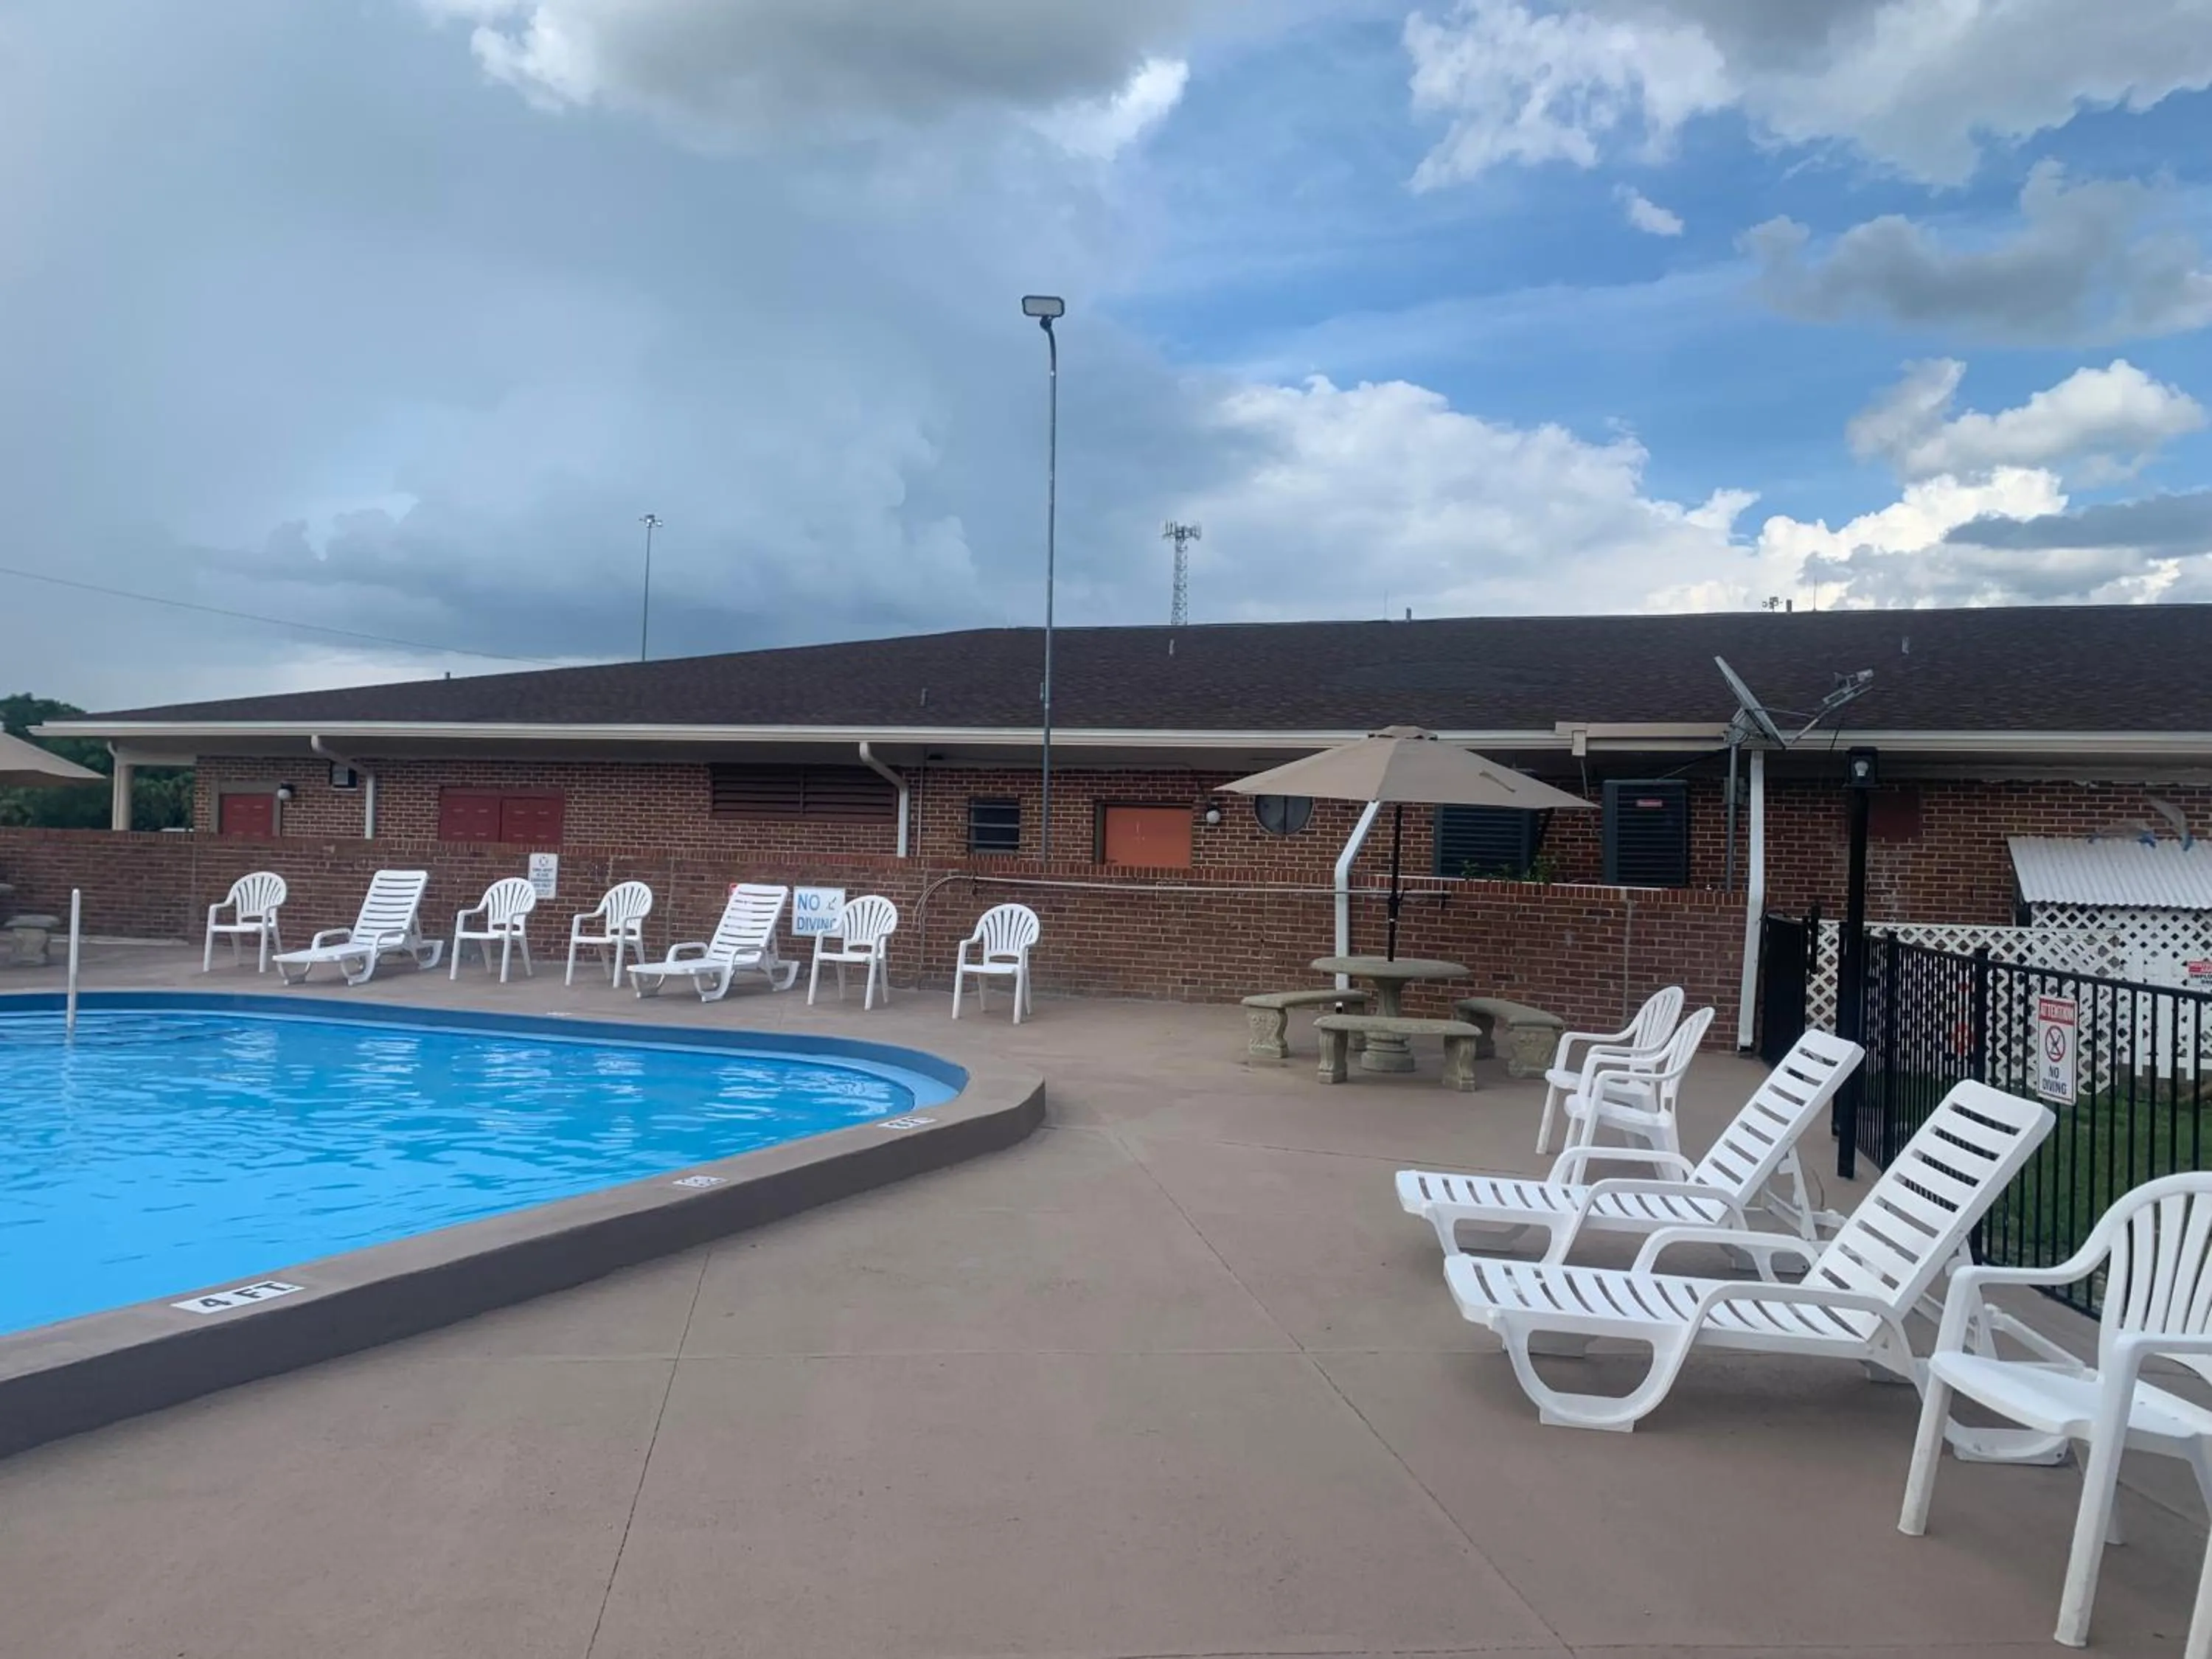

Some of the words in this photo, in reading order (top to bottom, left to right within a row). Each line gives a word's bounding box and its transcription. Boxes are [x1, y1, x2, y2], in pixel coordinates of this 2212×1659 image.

[797, 893, 821, 911] NO
[2048, 1065, 2059, 1079] NO
[2042, 1077, 2067, 1095] DIVING
[199, 1298, 232, 1307] 4
